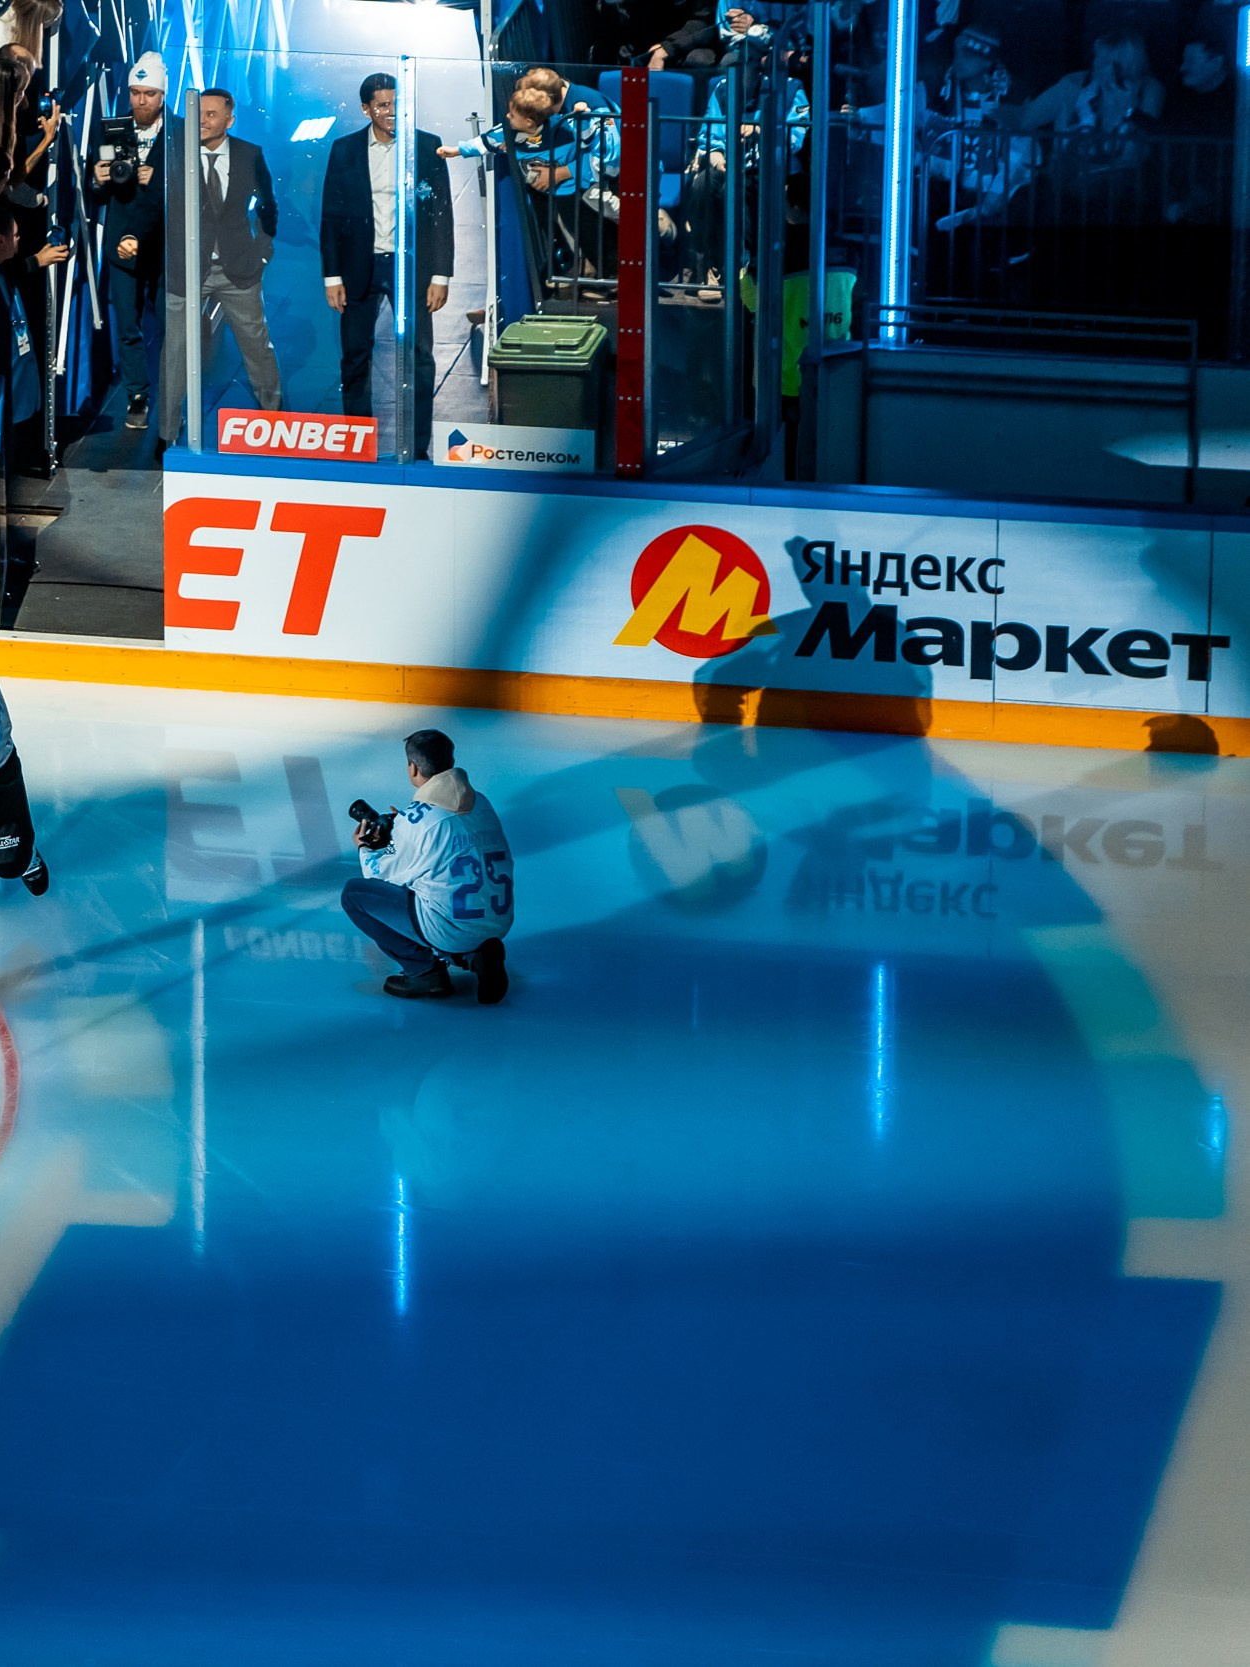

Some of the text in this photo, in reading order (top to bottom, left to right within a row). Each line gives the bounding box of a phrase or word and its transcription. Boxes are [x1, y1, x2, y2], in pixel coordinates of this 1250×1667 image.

[221, 417, 374, 453] FONBET
[471, 444, 581, 465] Ростелеком
[164, 497, 387, 636] ET
[801, 540, 1006, 597] Яндекс
[794, 601, 1231, 682] Маркет
[450, 852, 513, 919] 25
